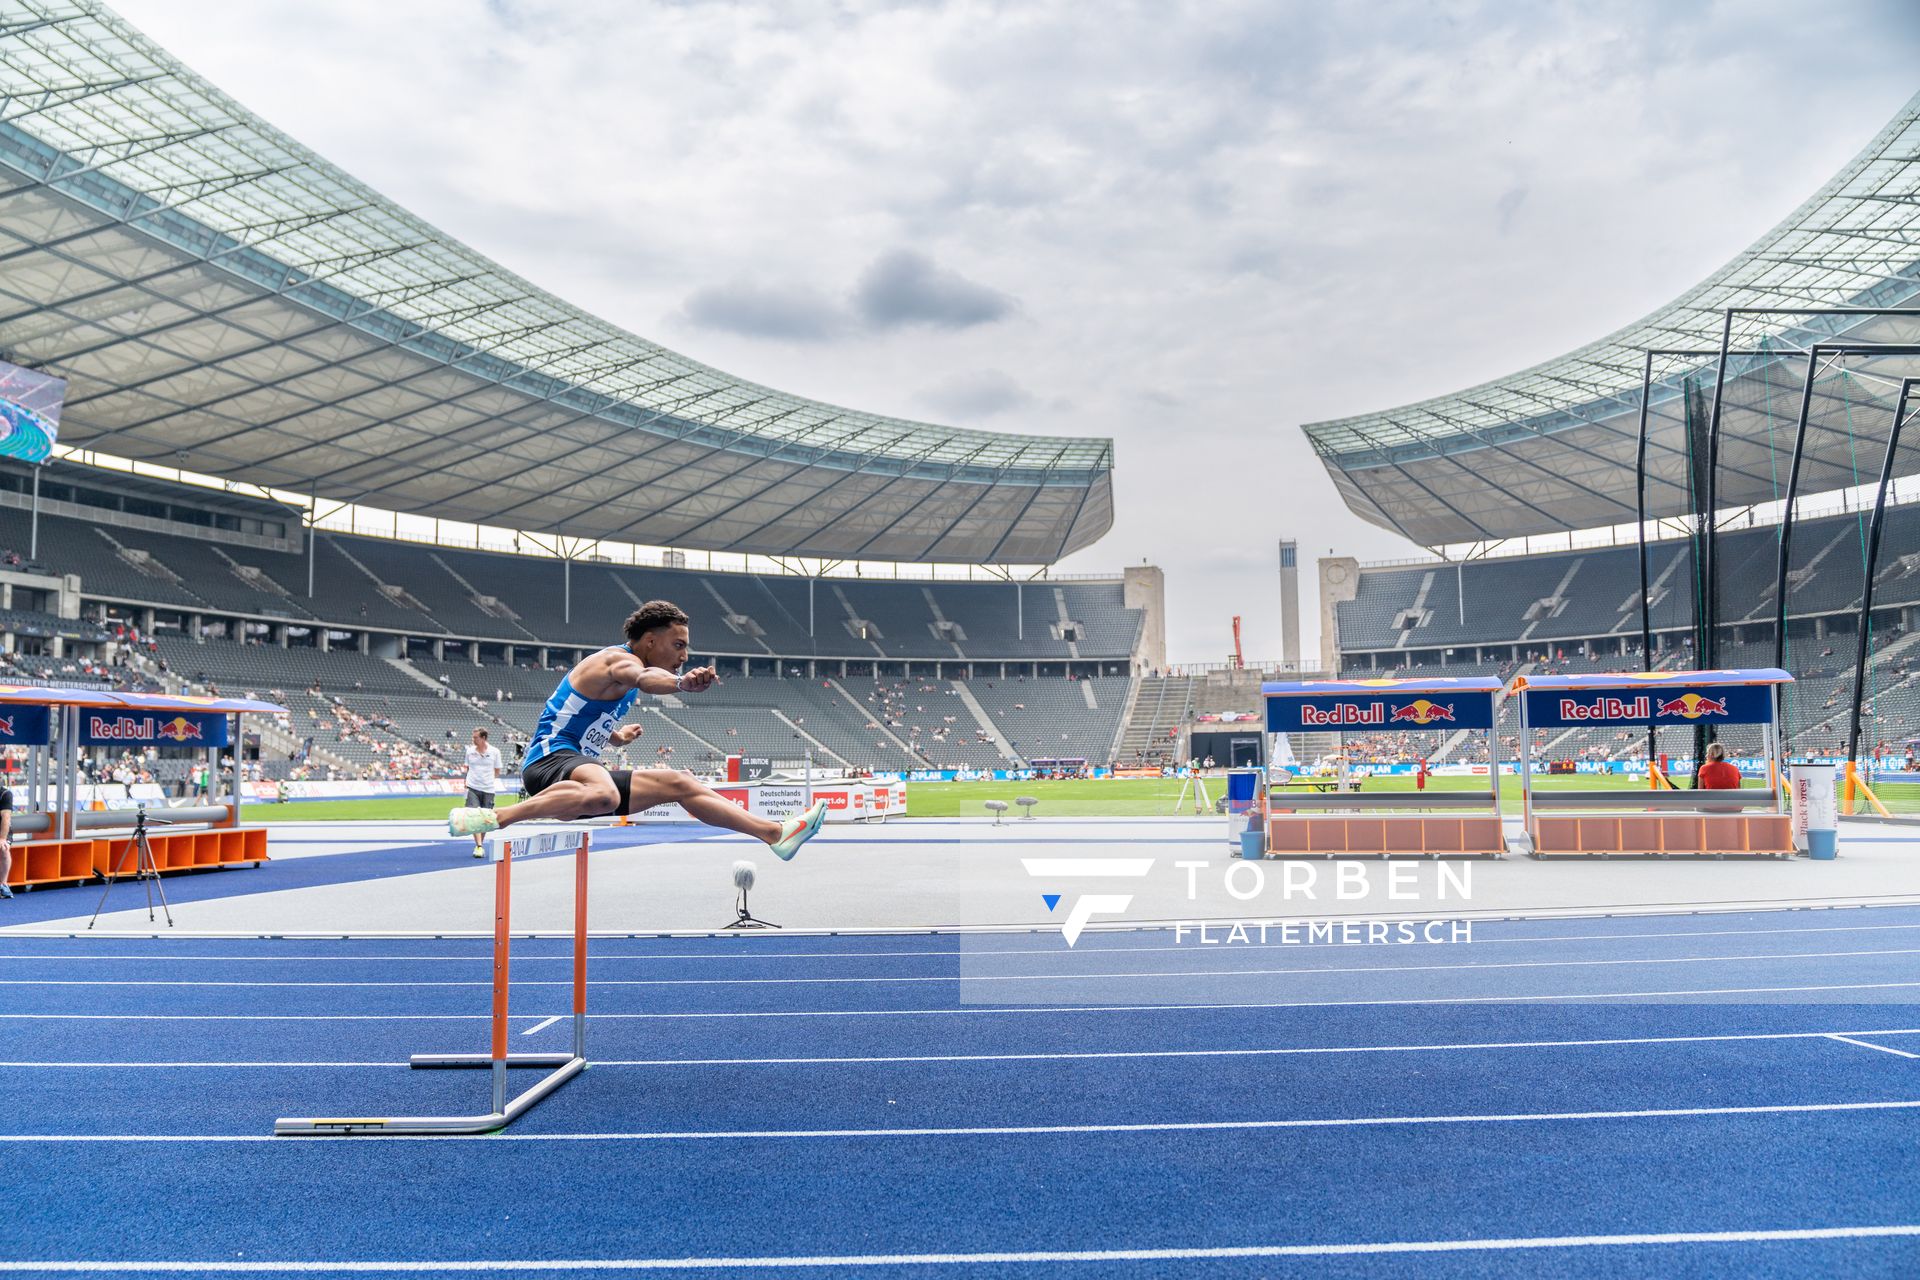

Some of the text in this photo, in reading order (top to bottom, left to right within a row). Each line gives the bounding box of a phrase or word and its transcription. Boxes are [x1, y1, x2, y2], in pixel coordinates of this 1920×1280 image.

[1364, 764, 1392, 774] PLAN
[918, 771, 942, 780] PLAN
[758, 800, 803, 808] meistgekaufte
